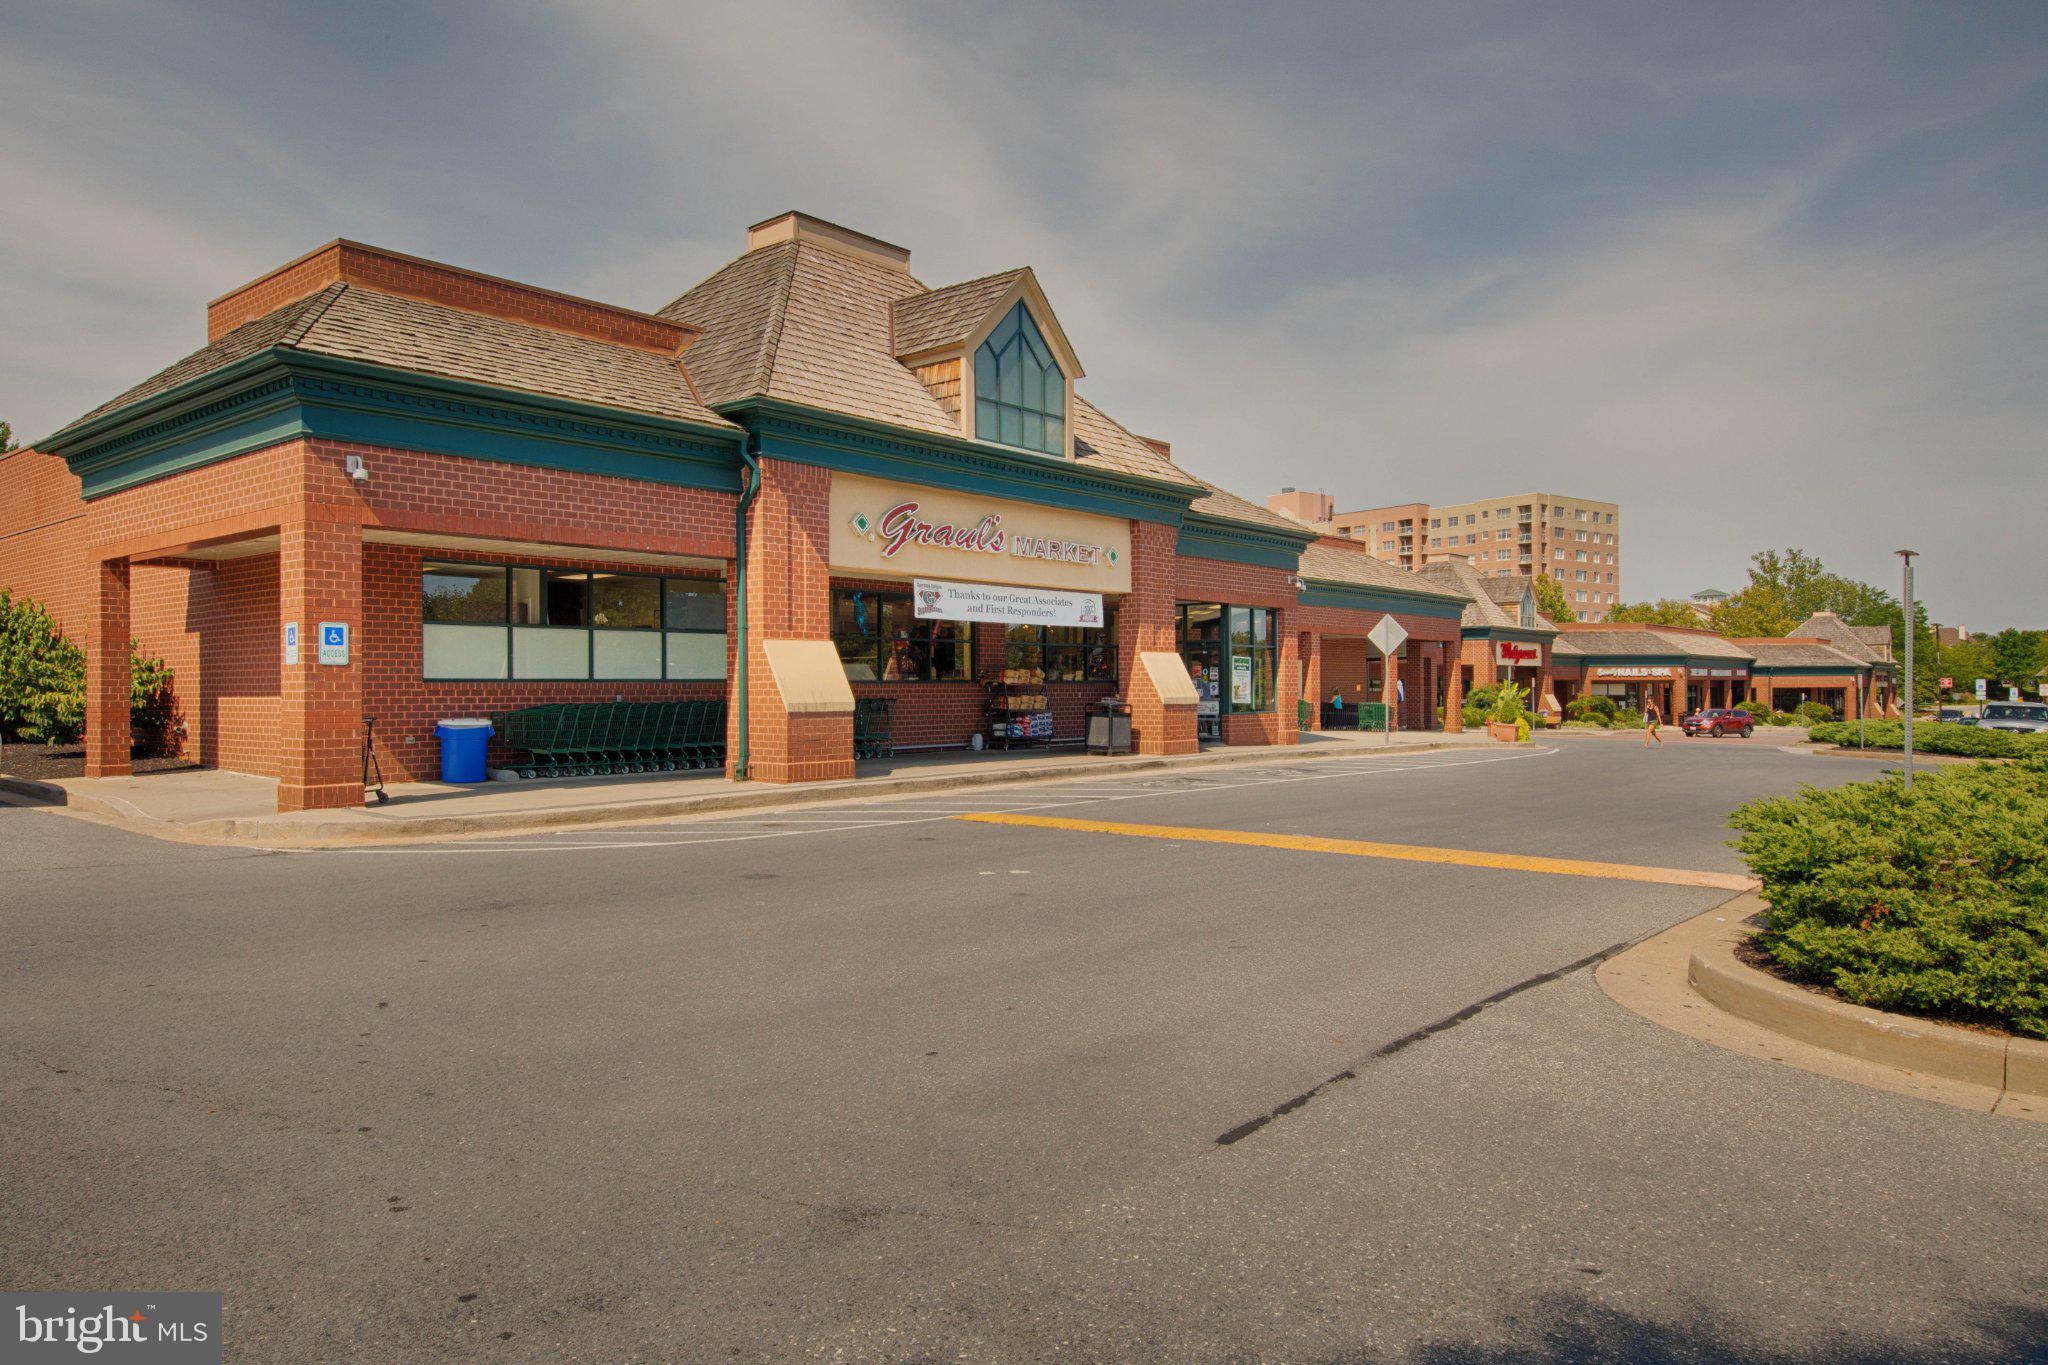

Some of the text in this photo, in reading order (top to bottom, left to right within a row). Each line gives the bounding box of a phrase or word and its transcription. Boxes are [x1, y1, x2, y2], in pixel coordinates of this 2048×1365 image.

[880, 502, 1102, 564] Graul's MARKET
[948, 589, 1073, 607] Thanks to our Great Associates
[967, 604, 1056, 618] and First Responders!
